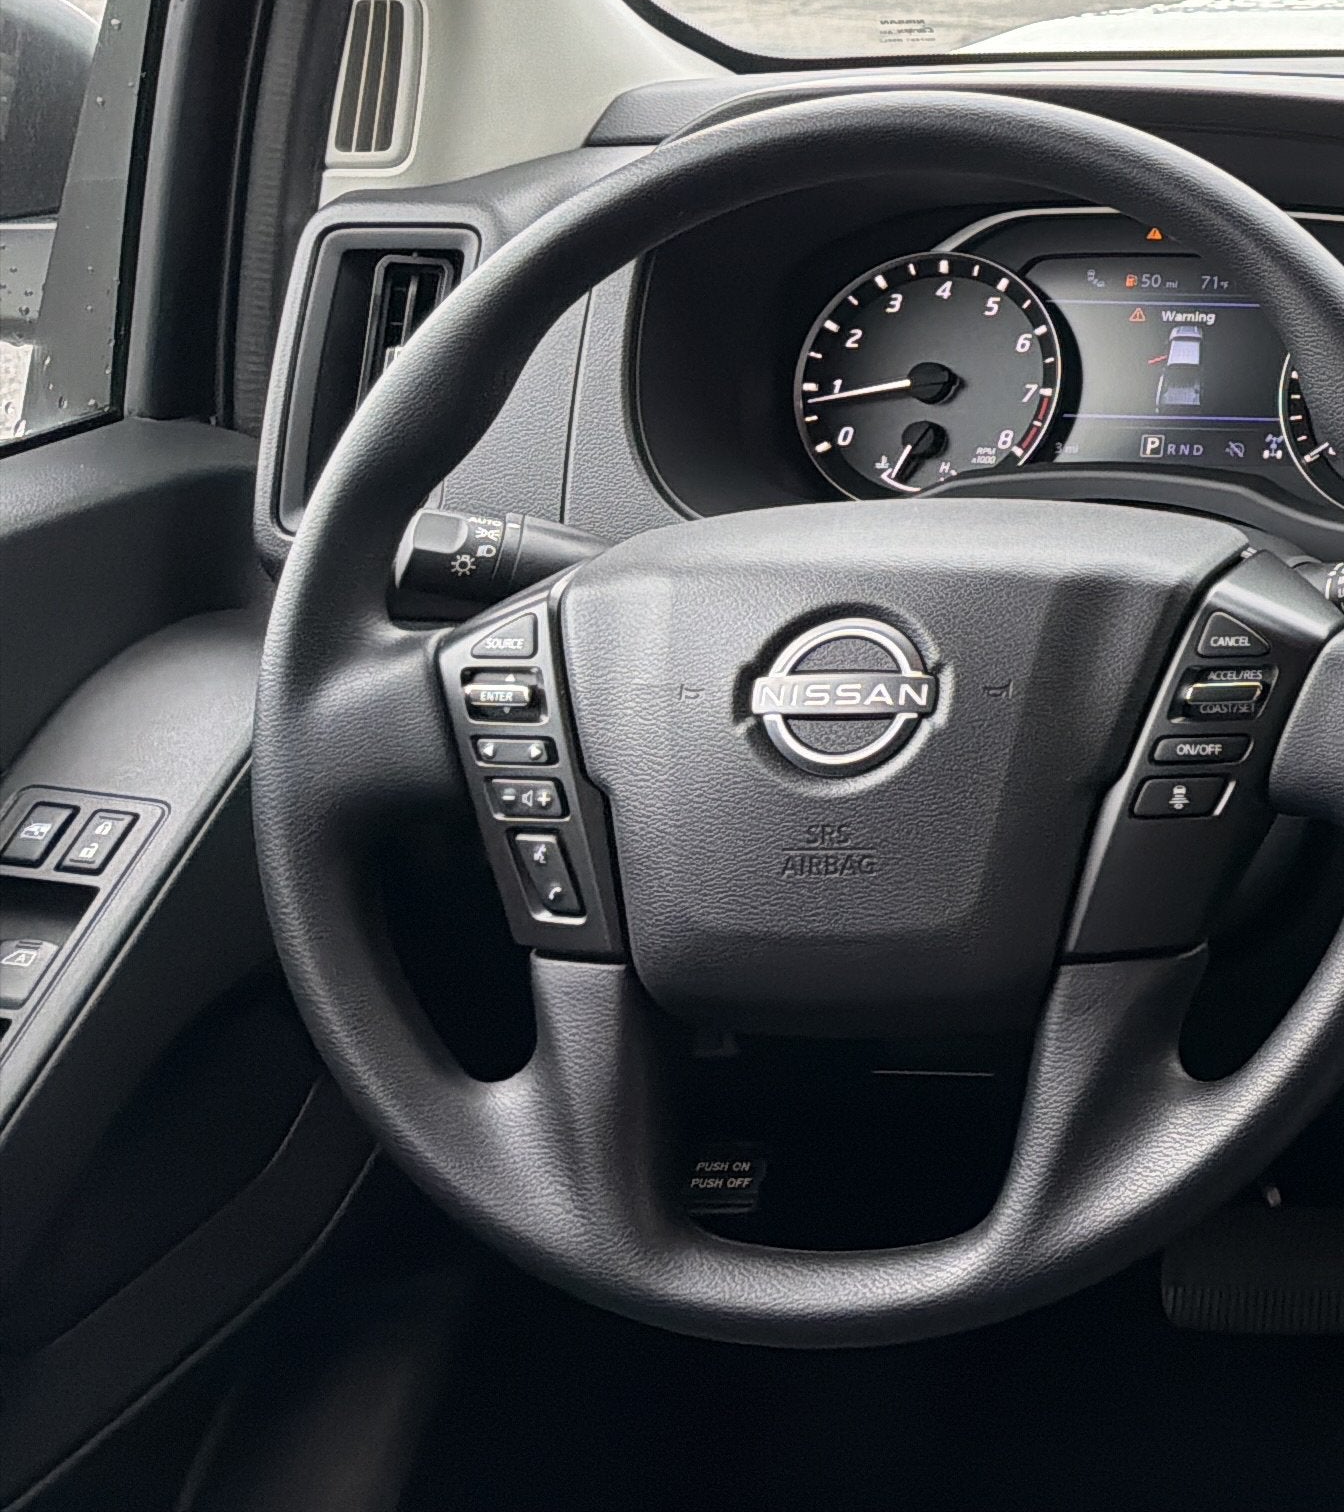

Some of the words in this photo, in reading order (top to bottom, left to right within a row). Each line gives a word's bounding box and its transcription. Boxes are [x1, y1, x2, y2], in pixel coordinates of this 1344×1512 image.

[1141, 274, 1161, 288] 50
[935, 281, 953, 300] 4
[886, 294, 903, 313] 3
[983, 297, 1001, 316] 5
[1161, 310, 1216, 325] Warning
[845, 329, 863, 348] 2
[1015, 334, 1032, 353] 6
[1021, 384, 1038, 403] 7
[837, 426, 854, 446] 0
[998, 430, 1014, 449] 8
[1146, 440, 1160, 454] P
[1168, 446, 1176, 455] R
[1180, 445, 1190, 455] N
[1193, 445, 1203, 455] D
[468, 516, 503, 527] AUTO
[485, 638, 524, 650] SOURCE
[1210, 637, 1251, 646] CANCEL
[1208, 670, 1263, 680] ACCEL/RES
[480, 692, 513, 701] ENTER
[760, 684, 929, 706] NISSAN
[1200, 704, 1256, 714] COAST/SET
[1176, 744, 1222, 755] ON/OFF
[806, 824, 851, 845] SRS
[781, 855, 878, 876] AIRBAG
[696, 1162, 729, 1171] PUSH
[733, 1161, 751, 1171] ON
[691, 1178, 724, 1188] PUSH
[727, 1178, 752, 1188] OFF
